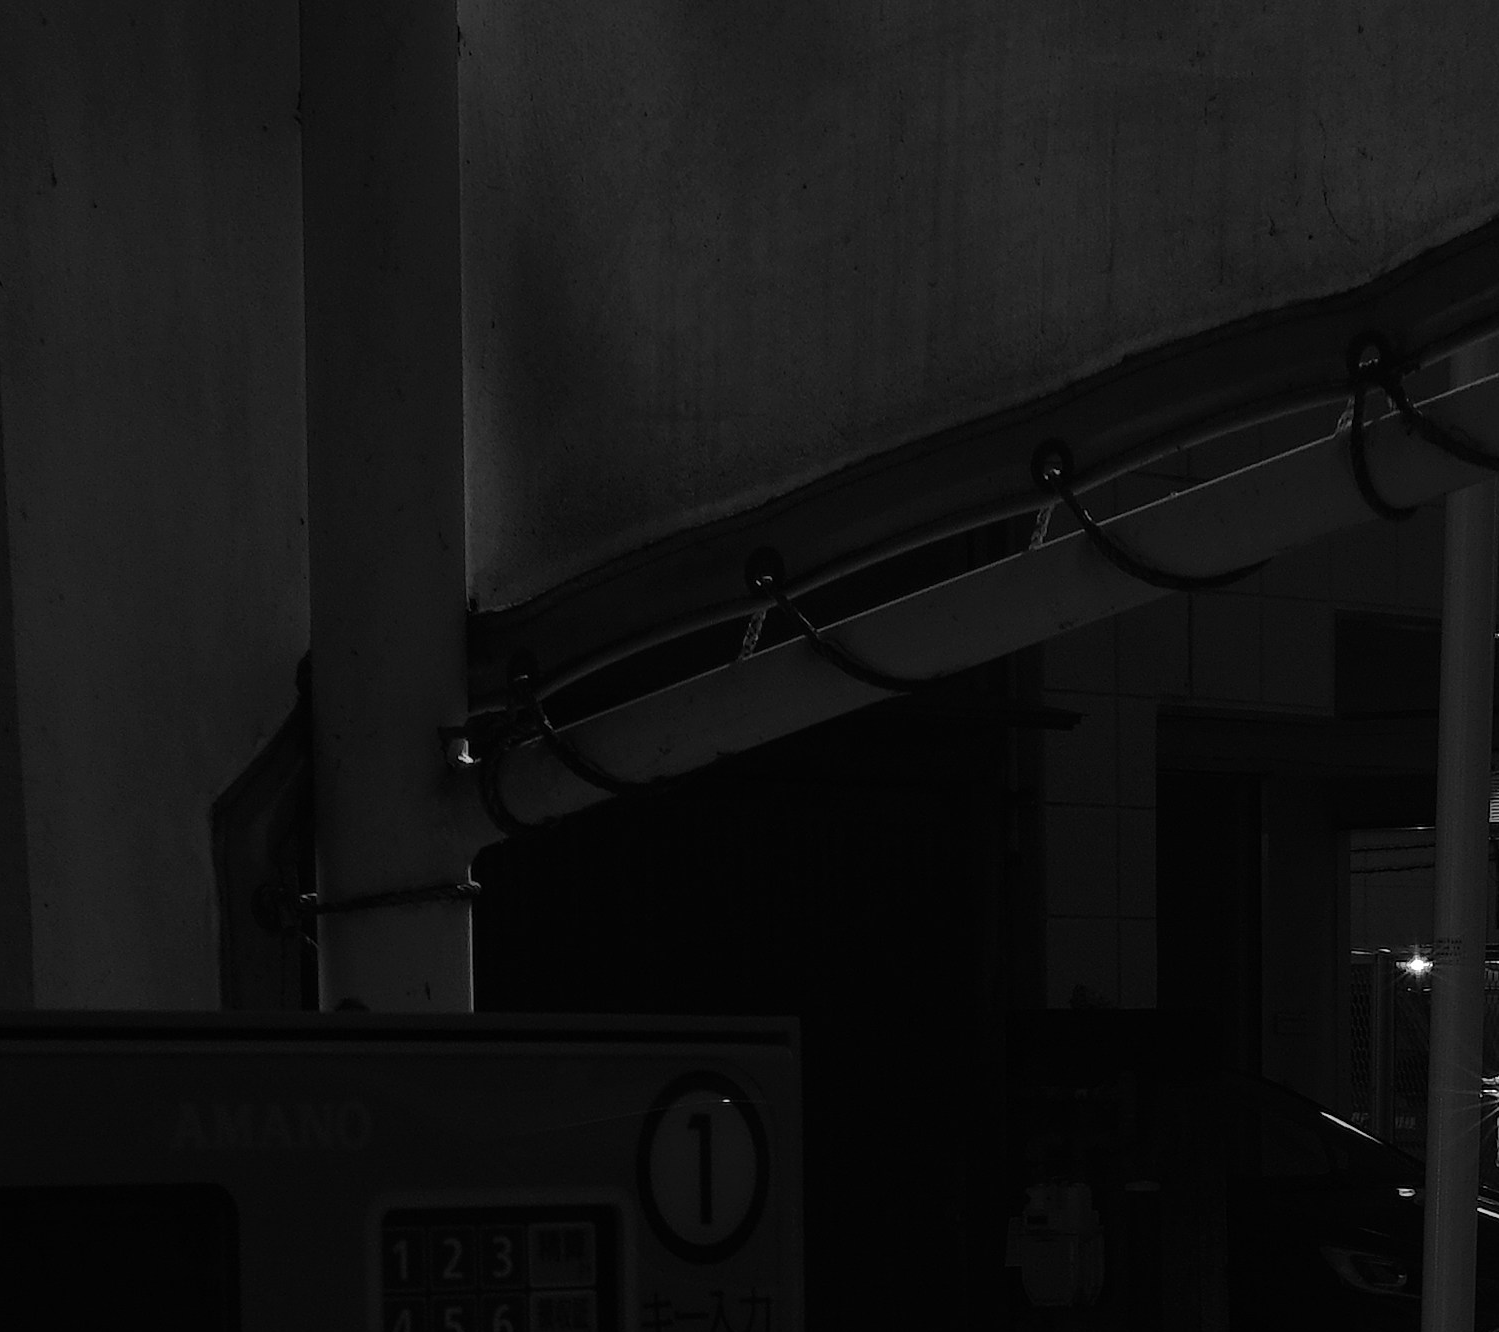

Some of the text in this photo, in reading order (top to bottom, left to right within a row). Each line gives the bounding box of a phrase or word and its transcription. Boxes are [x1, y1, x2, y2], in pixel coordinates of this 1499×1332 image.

[169, 1100, 374, 1152] AMANO
[392, 1235, 514, 1281] 1 2 3
